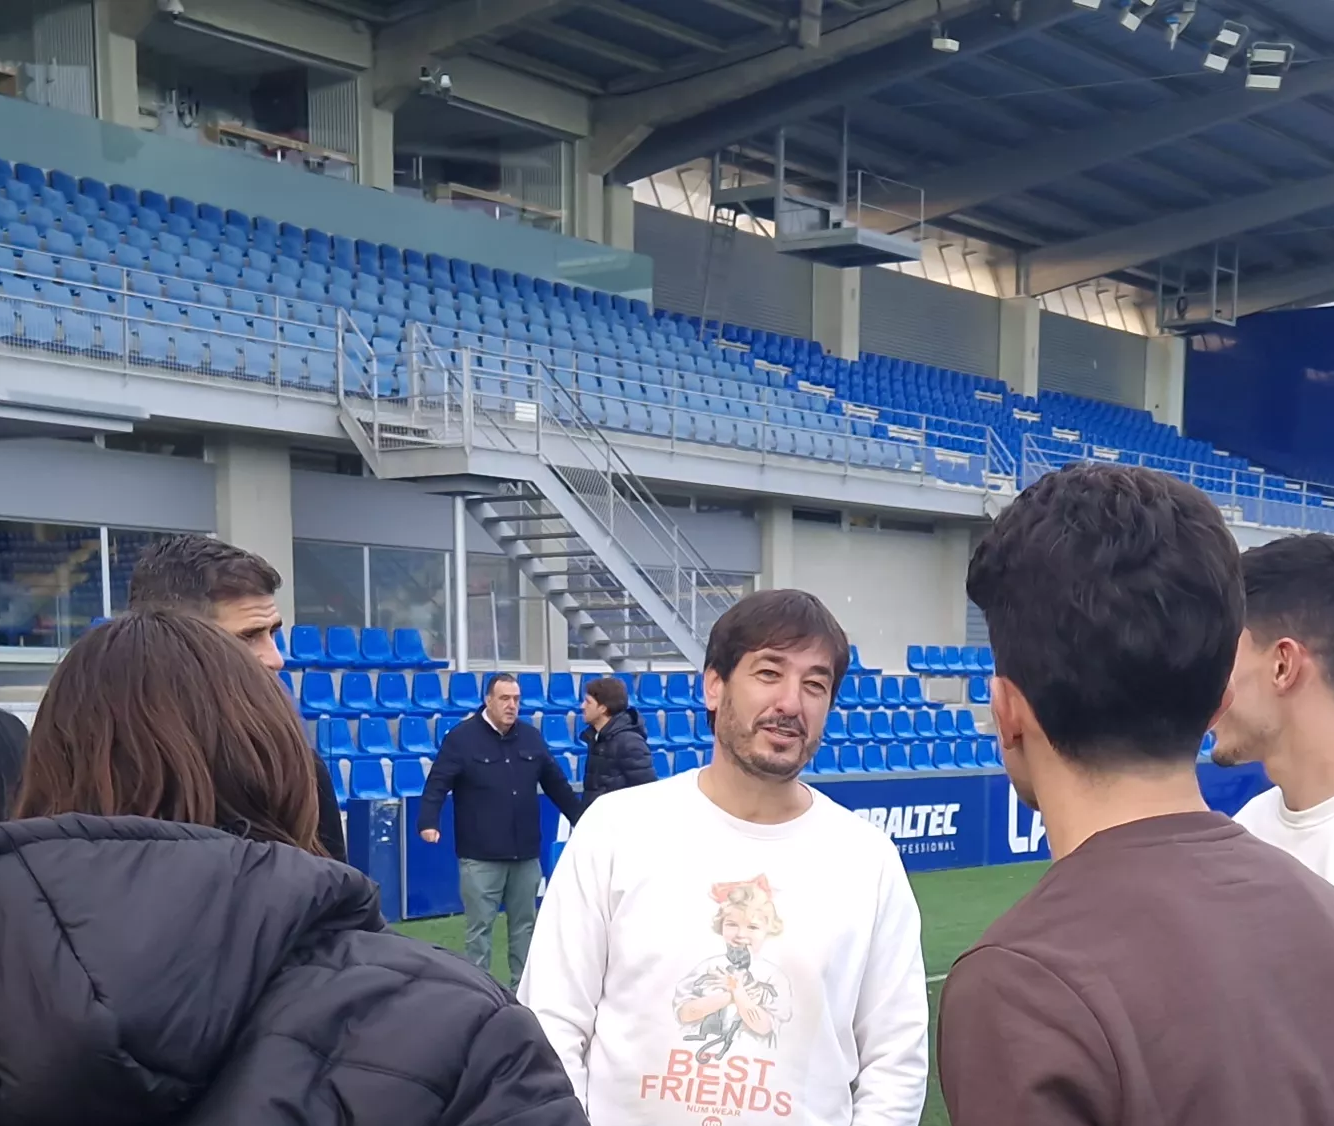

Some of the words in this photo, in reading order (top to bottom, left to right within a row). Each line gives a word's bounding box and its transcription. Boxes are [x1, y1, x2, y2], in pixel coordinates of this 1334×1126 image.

[667, 1048, 775, 1087] BEST
[640, 1074, 792, 1117] FRIENDS
[686, 1104, 709, 1114] NUM
[712, 1106, 741, 1117] WEAR
